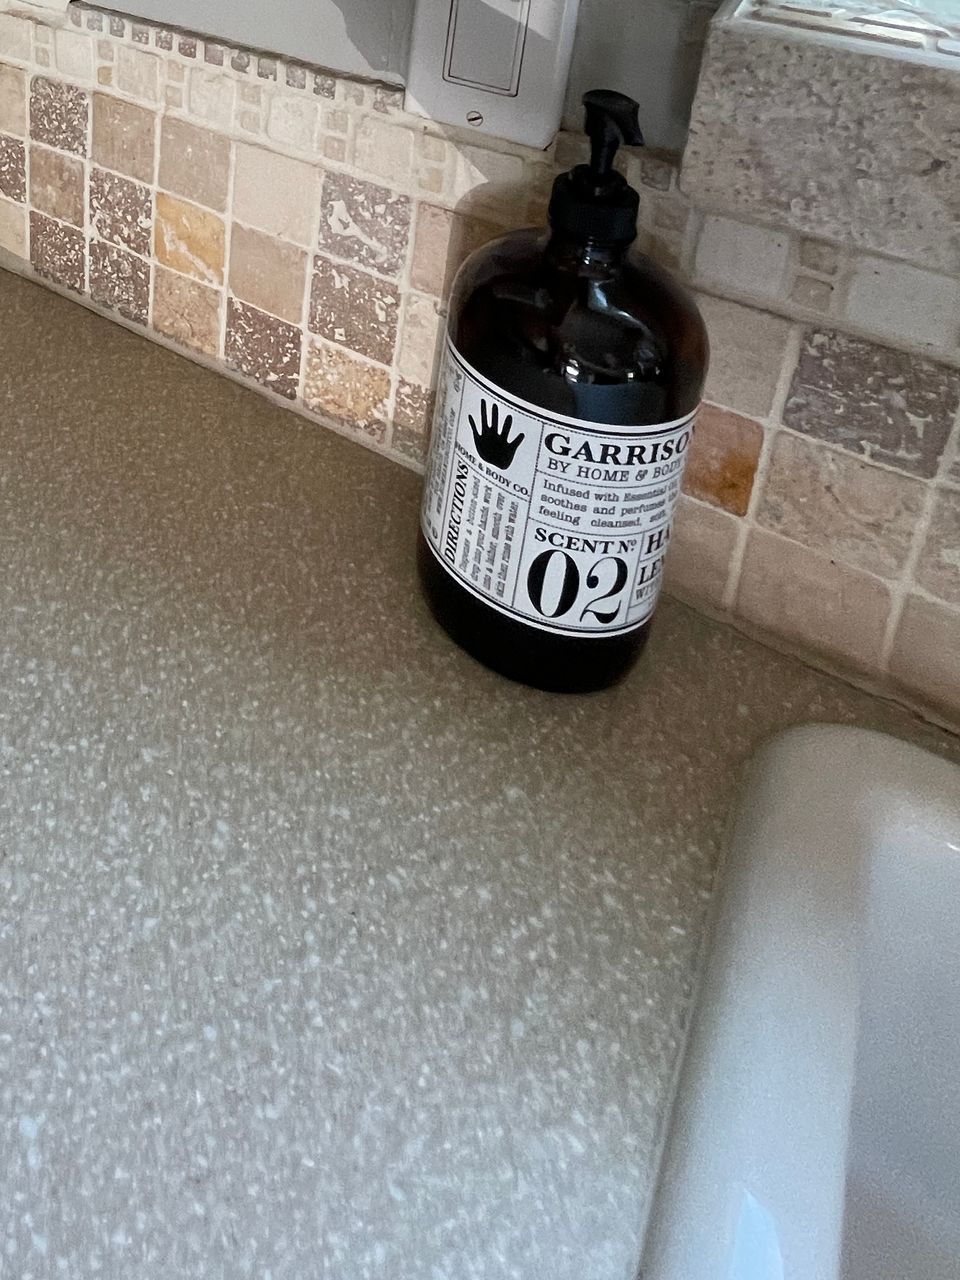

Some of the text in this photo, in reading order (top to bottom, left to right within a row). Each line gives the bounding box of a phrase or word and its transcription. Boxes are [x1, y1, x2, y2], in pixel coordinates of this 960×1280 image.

[544, 427, 693, 466] GARRISO
[455, 440, 530, 497] HOME & BODY CO.
[547, 457, 571, 474] BY
[576, 465, 630, 482] HOME
[635, 469, 648, 482] &
[543, 479, 590, 500] Infused
[594, 491, 620, 502] with
[444, 460, 469, 565] DIRECTIONS
[538, 505, 581, 526] feeling
[541, 494, 587, 512] soothes
[592, 505, 616, 516] and
[534, 527, 614, 554] SCENT
[527, 549, 628, 624] 02
